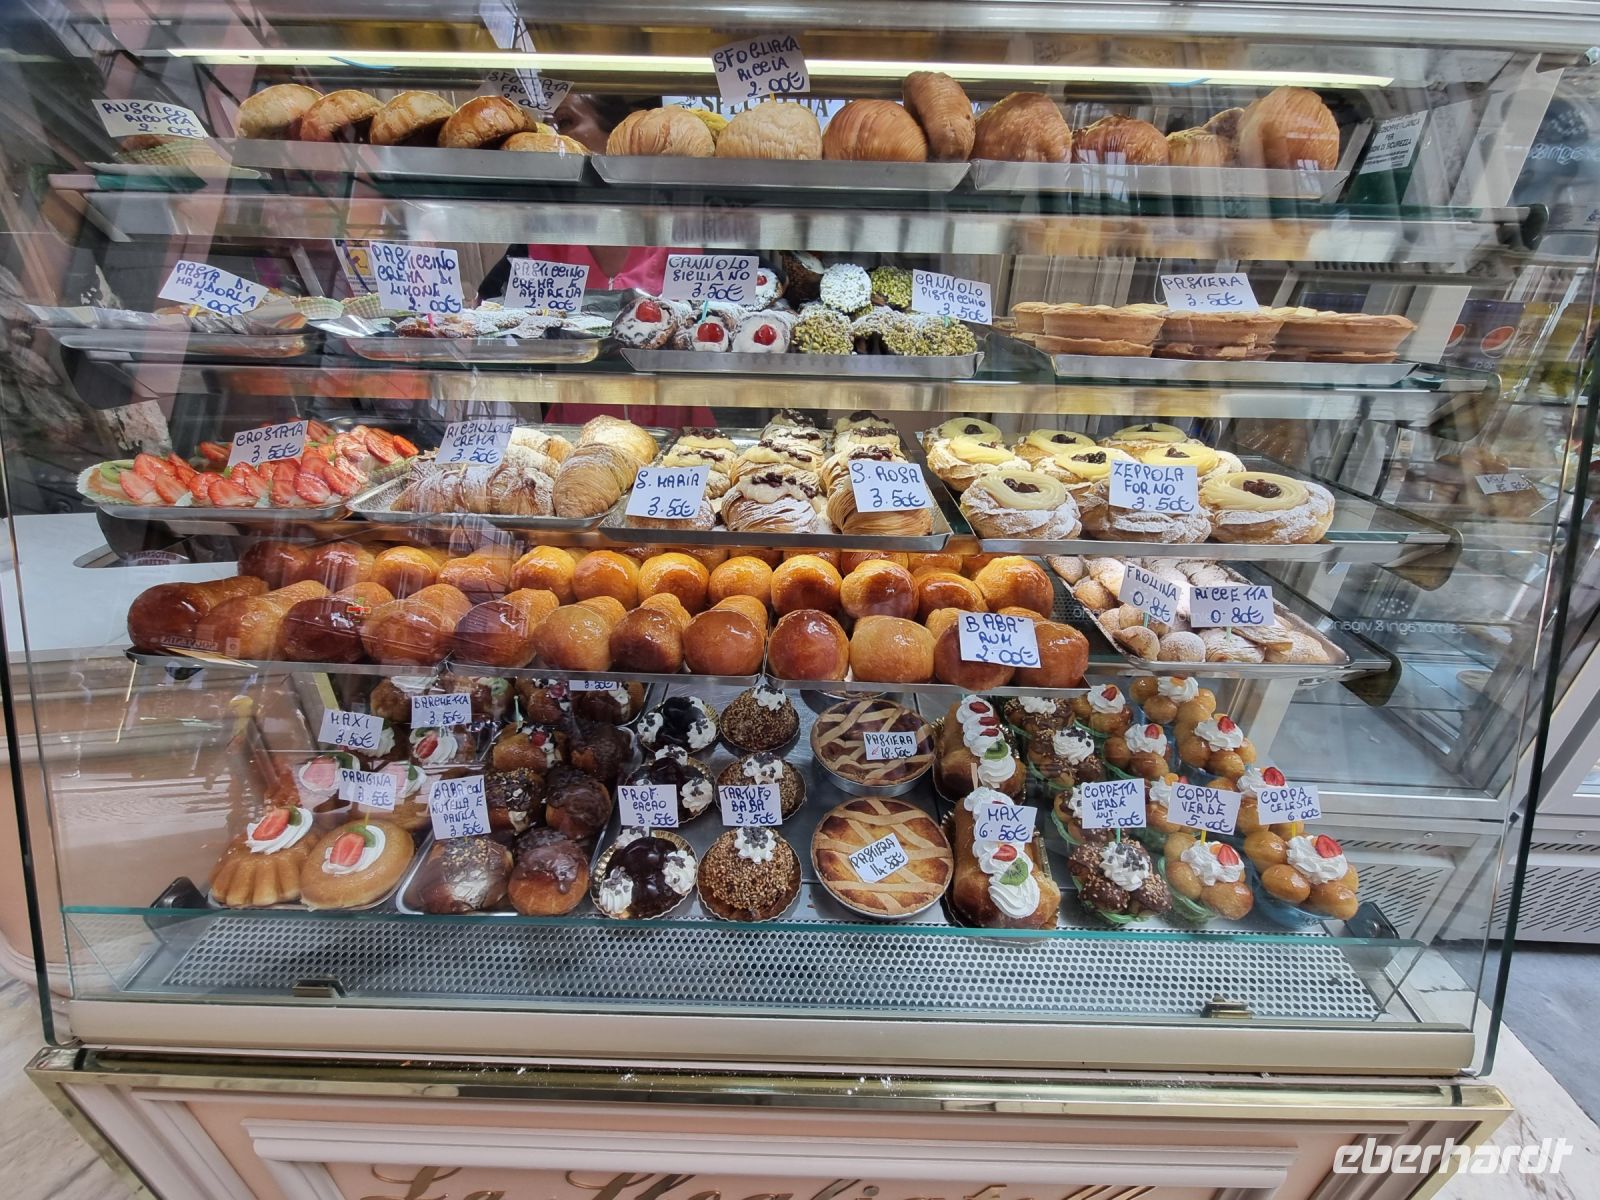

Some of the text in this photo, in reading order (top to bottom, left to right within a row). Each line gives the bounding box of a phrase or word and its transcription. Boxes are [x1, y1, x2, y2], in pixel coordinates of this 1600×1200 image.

[714, 36, 800, 72] SFOGLIATA
[488, 71, 569, 92] SFOATA
[101, 102, 187, 118] RUSTICO
[124, 114, 196, 127] RICOTTA
[371, 244, 456, 271] PASTICCINO
[668, 256, 749, 270] CANNOLO
[176, 262, 220, 283] PASTA
[377, 264, 425, 282] CREMA
[673, 269, 750, 281] SICILIANO
[390, 282, 440, 297] LIMONE
[512, 277, 555, 290] CREMA
[915, 273, 983, 297] CANNOLO
[1162, 275, 1244, 290] PASTIERA
[175, 276, 257, 308] MANDORLA
[519, 287, 582, 298] AMARENA
[921, 286, 986, 308] PISTACCHIO
[236, 422, 303, 447] CROSTATA
[453, 434, 495, 447] CREMA
[635, 469, 700, 489] S. MARIA
[851, 462, 920, 484] S. ROSA
[1113, 462, 1185, 482] ZEPPOLA
[1124, 479, 1175, 496] FORNO
[1126, 565, 1177, 601] FROLLINA
[978, 631, 1012, 646] RUM
[331, 711, 369, 729] MAXI
[865, 733, 913, 747] PASTIERA
[342, 770, 392, 786] PARIGINA
[720, 786, 771, 801] TARTUFO
[1084, 781, 1138, 798] COPPETTA
[1176, 785, 1222, 803] COPPA
[1261, 786, 1308, 804] COPPA
[432, 797, 470, 814] NUTELLA
[632, 800, 667, 811] CACAO
[1092, 796, 1126, 811] VERDE
[1181, 801, 1226, 816] VERDE
[1270, 797, 1313, 812] CELESTE
[443, 809, 477, 823] PANNA
[987, 806, 1024, 822] MAX
[850, 837, 896, 869] PASTIERA
